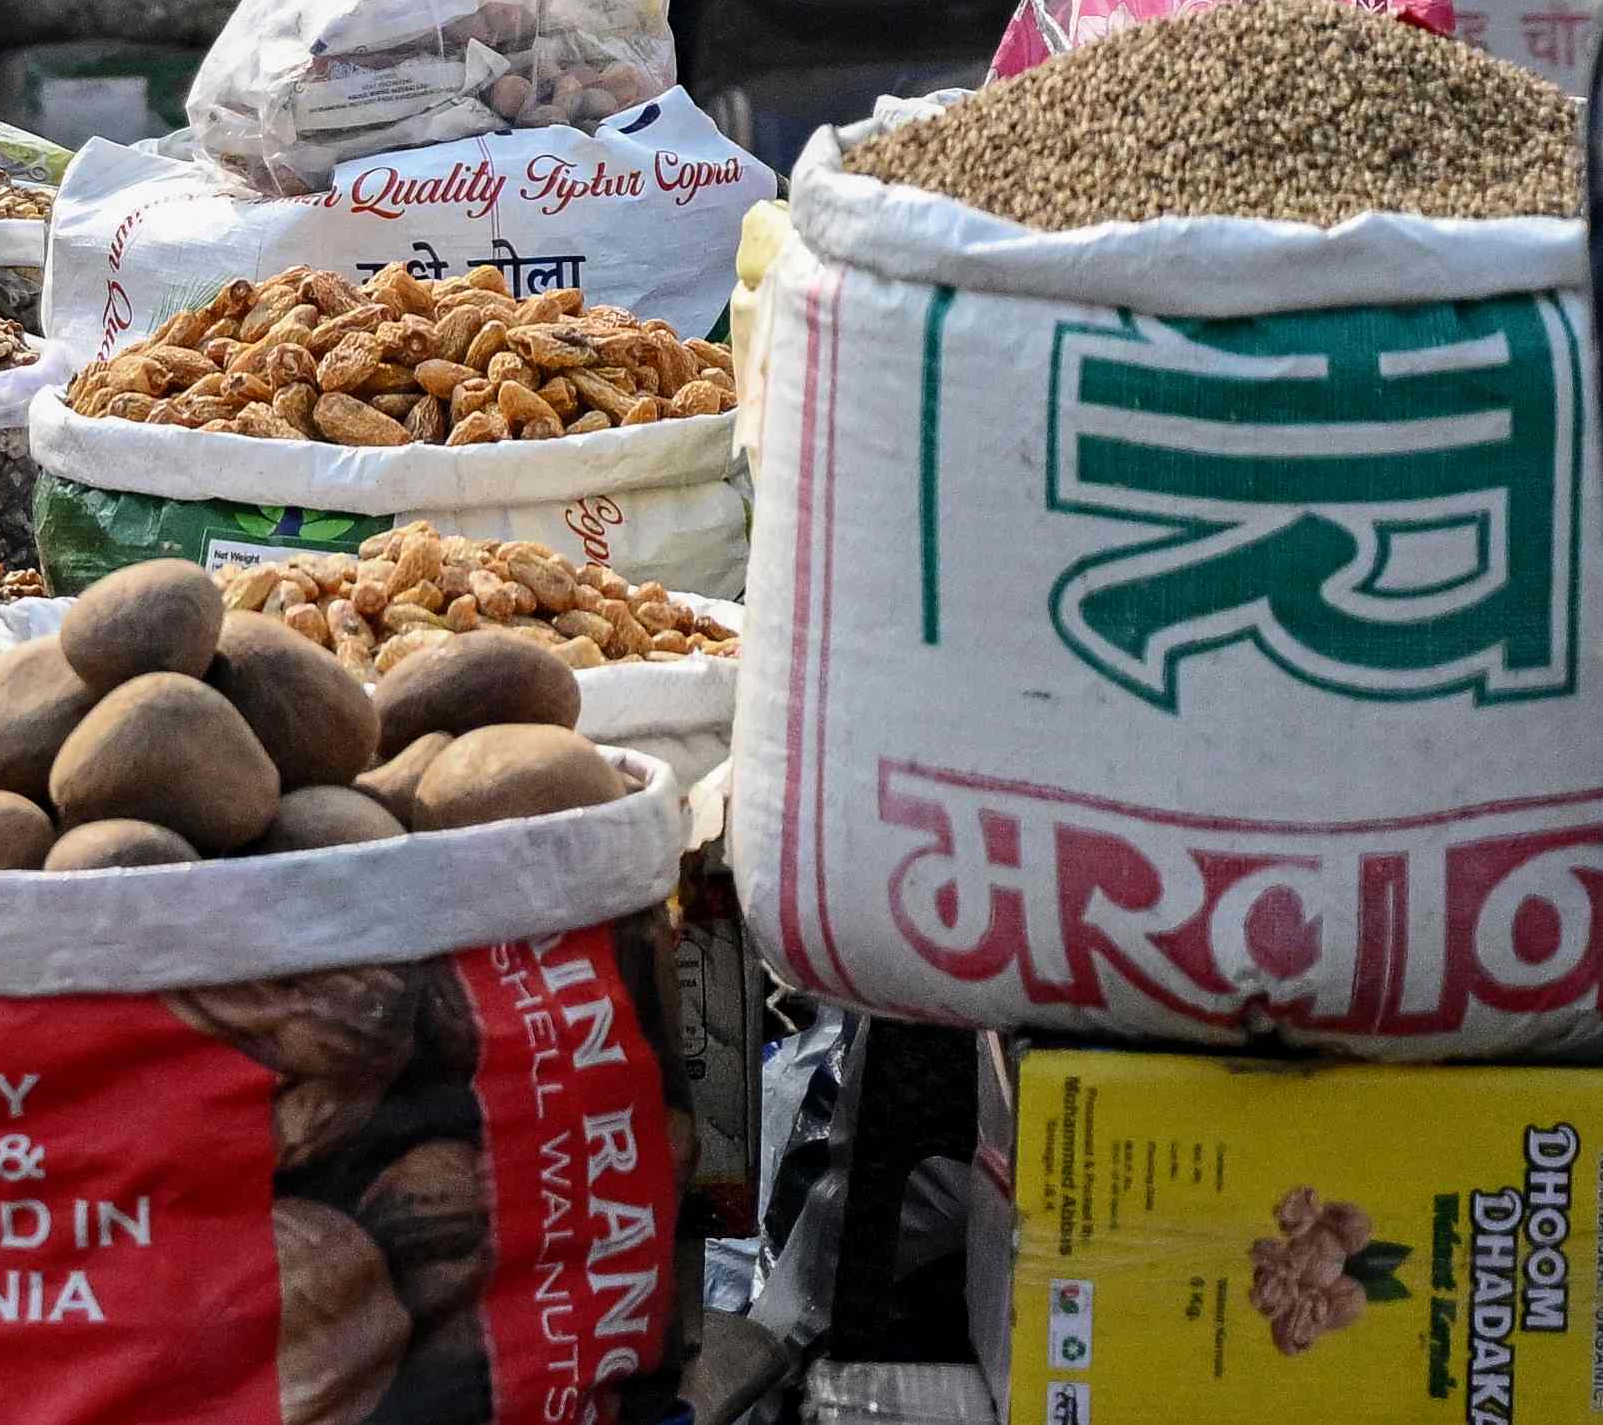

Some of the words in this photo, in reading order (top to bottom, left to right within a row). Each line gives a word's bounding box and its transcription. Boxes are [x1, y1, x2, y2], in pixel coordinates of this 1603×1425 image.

[350, 158, 507, 220] Quality
[519, 153, 646, 216] Tiptur
[654, 150, 744, 206] Copra
[73, 1194, 153, 1248] IN
[534, 1128, 582, 1425] WALNUTS
[1521, 1121, 1581, 1333] DHOOM
